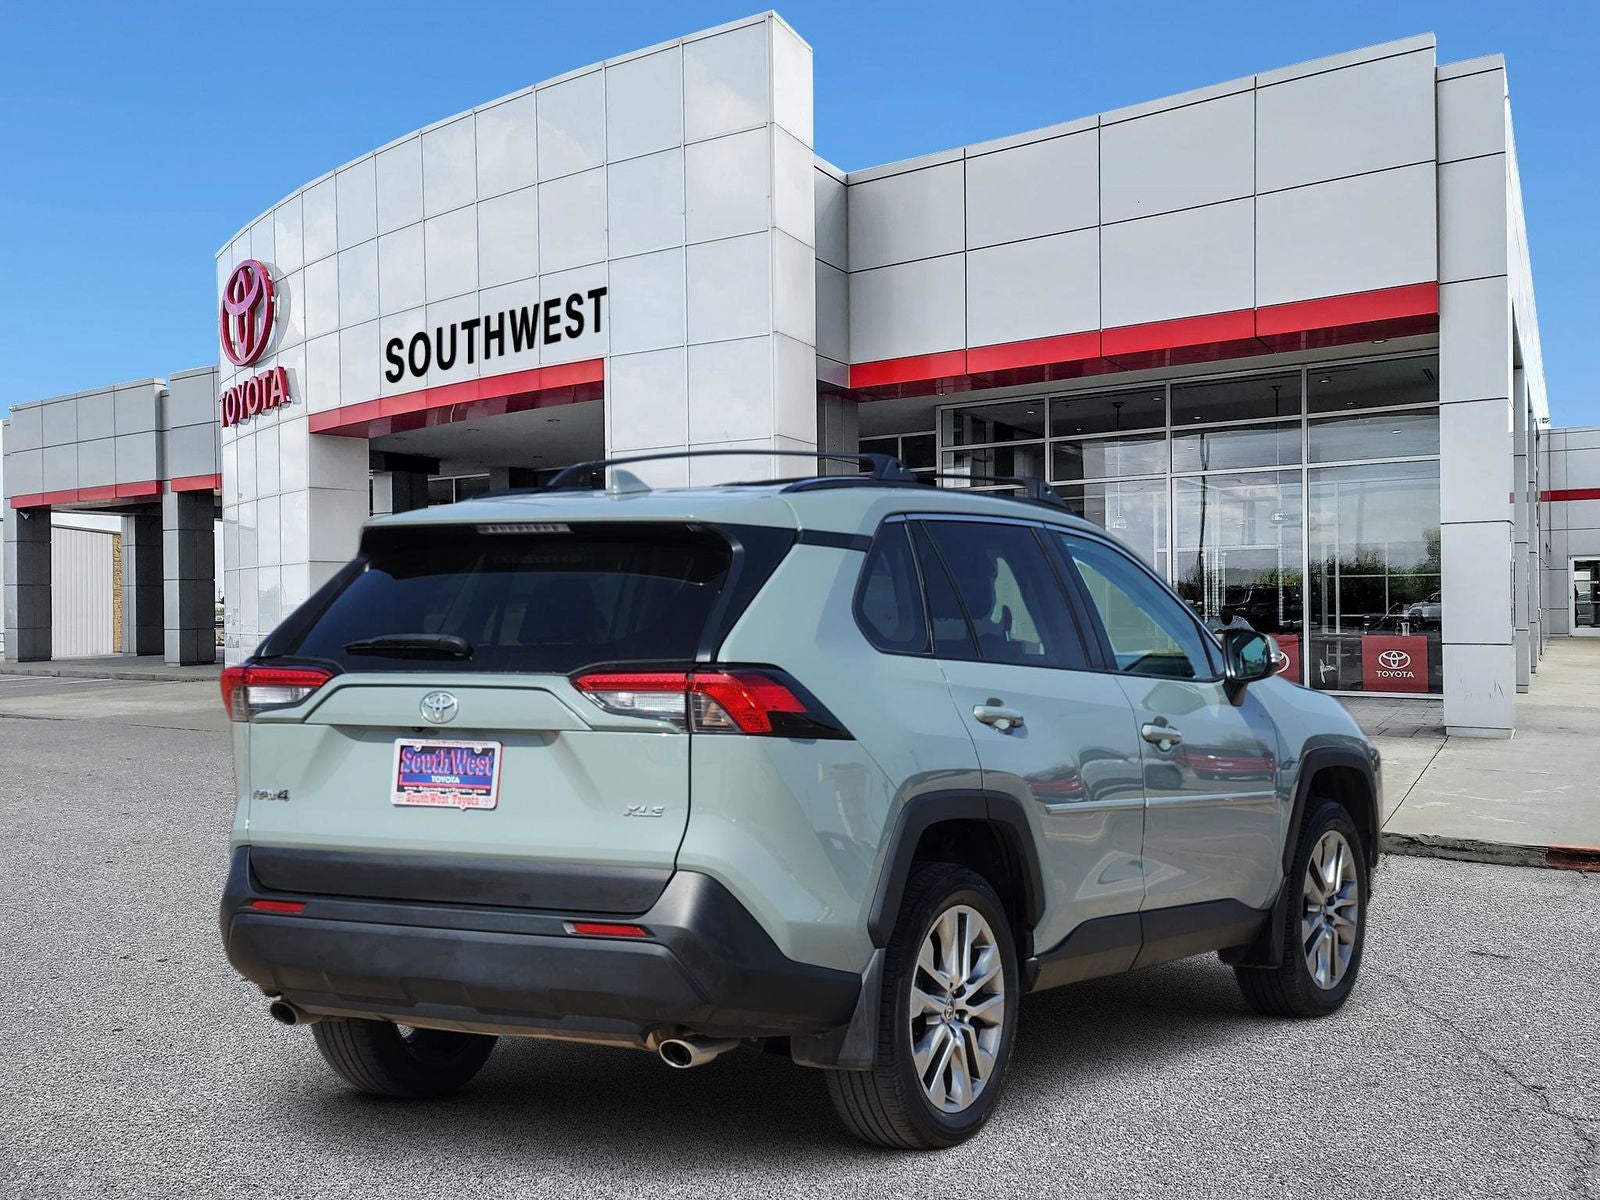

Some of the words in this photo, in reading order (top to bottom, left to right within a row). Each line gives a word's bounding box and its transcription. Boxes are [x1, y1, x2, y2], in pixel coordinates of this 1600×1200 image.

[385, 286, 608, 384] SOUTHWEST
[218, 366, 291, 428] TOYOTA
[1376, 669, 1415, 679] TOYOTA
[431, 775, 461, 784] TOYOTA
